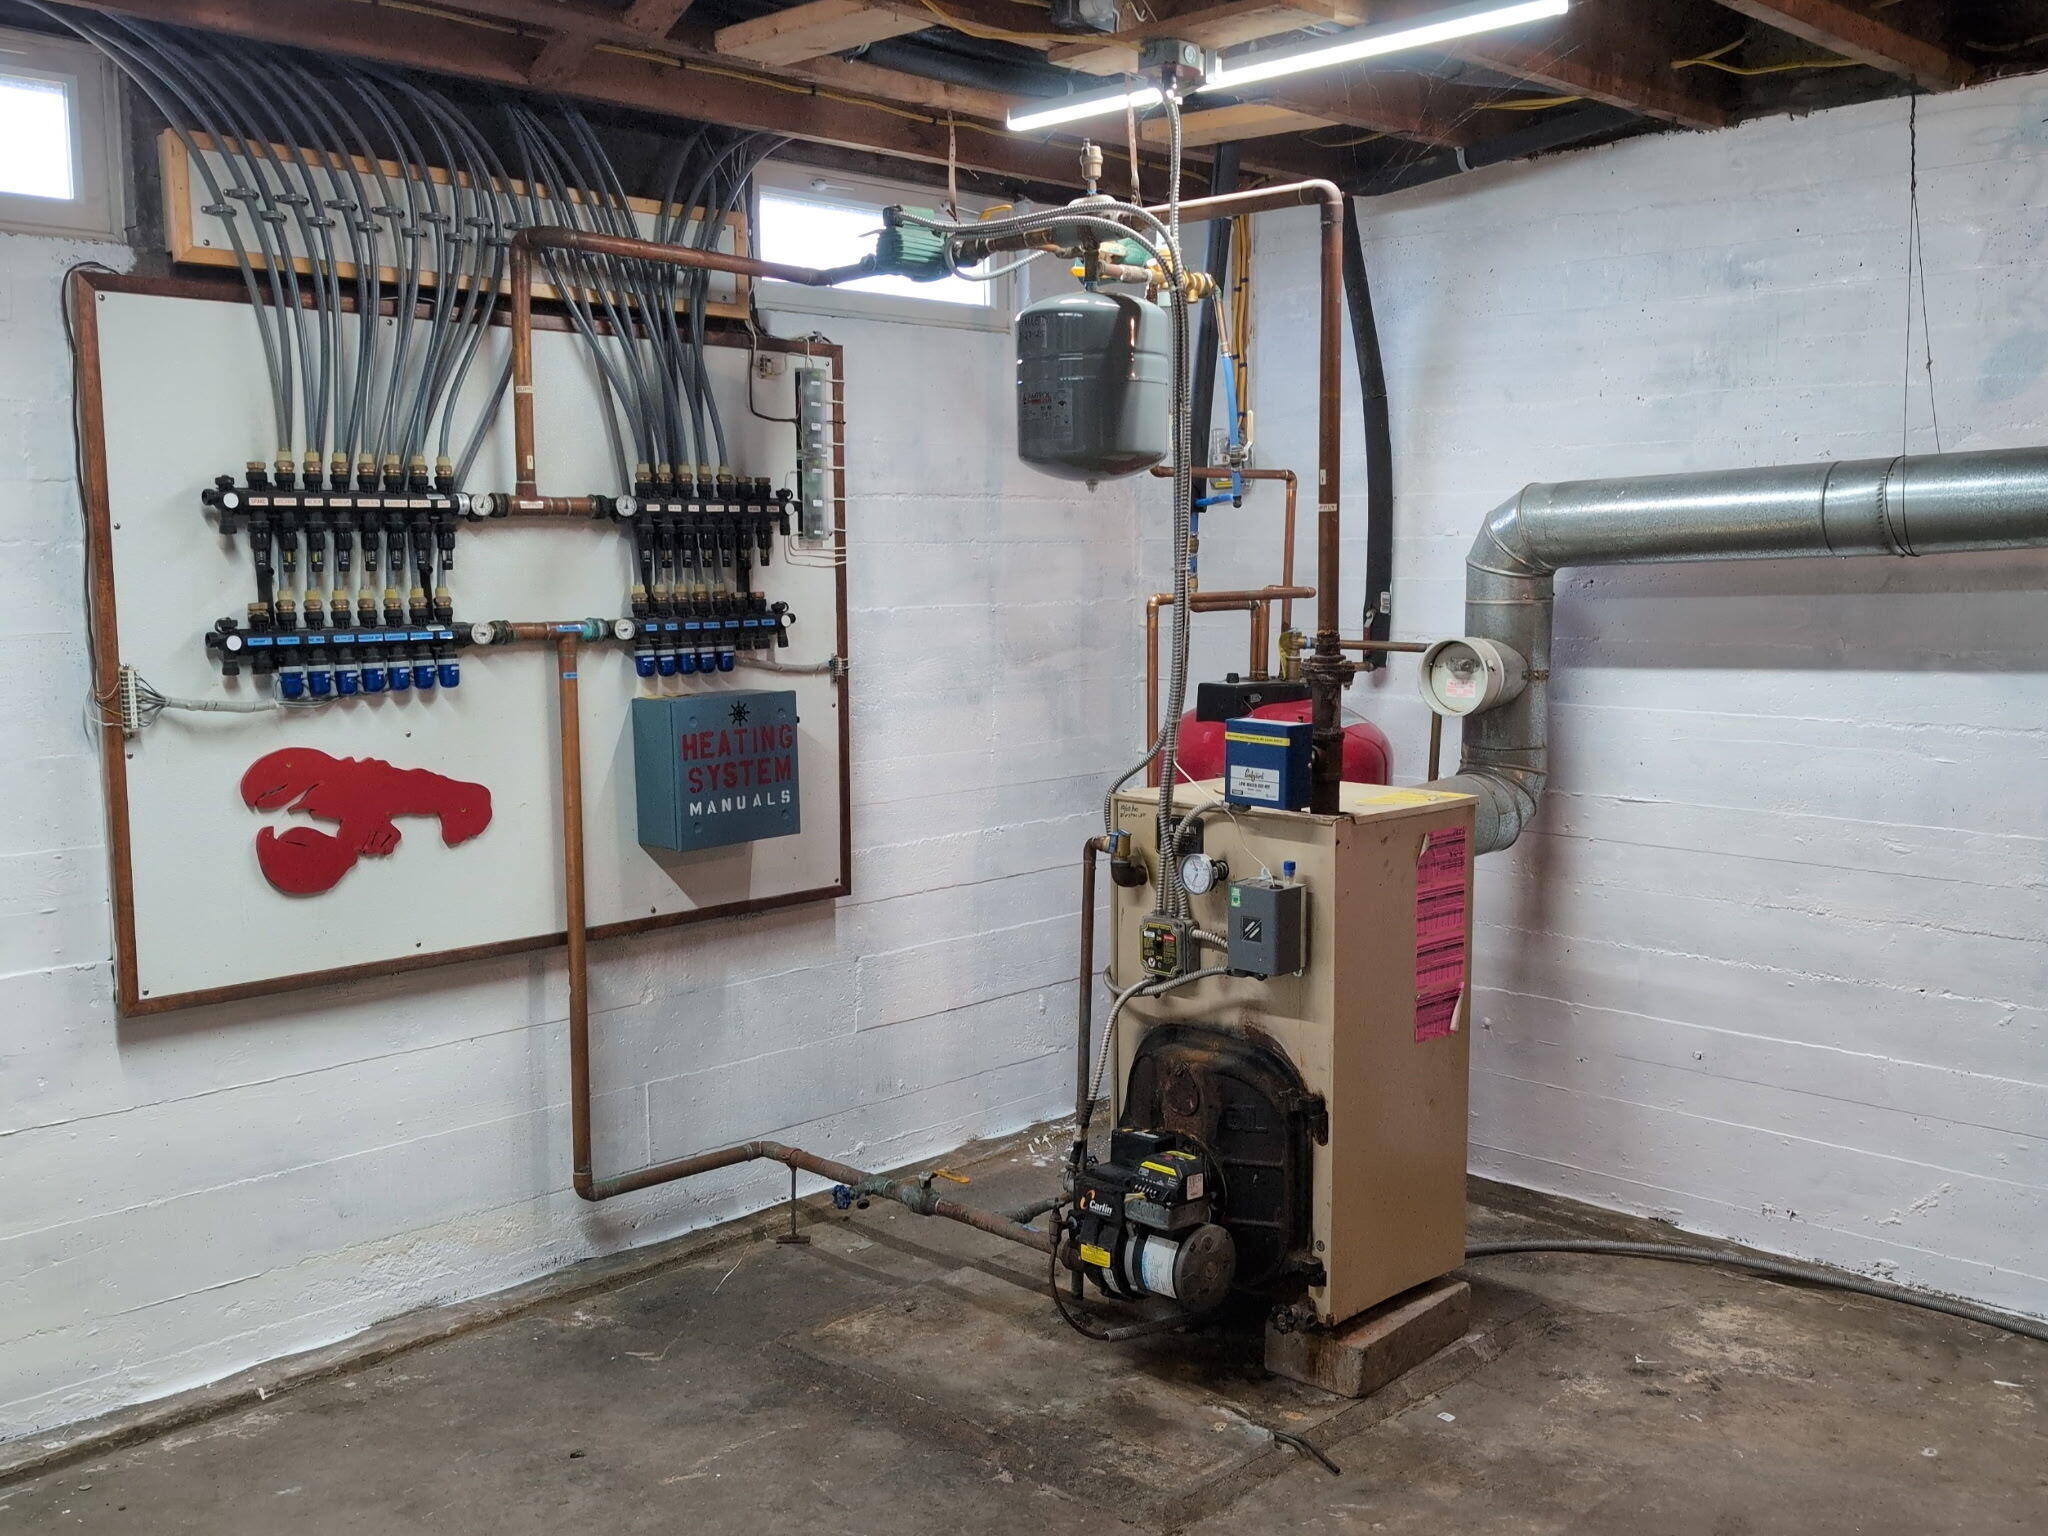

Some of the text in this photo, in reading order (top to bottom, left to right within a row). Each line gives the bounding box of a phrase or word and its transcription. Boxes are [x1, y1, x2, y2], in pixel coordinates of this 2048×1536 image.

[681, 724, 793, 761] HEATING
[688, 755, 791, 794] SYSTEM
[689, 790, 790, 816] MANUALS
[1089, 1199, 1113, 1215] Carlin
